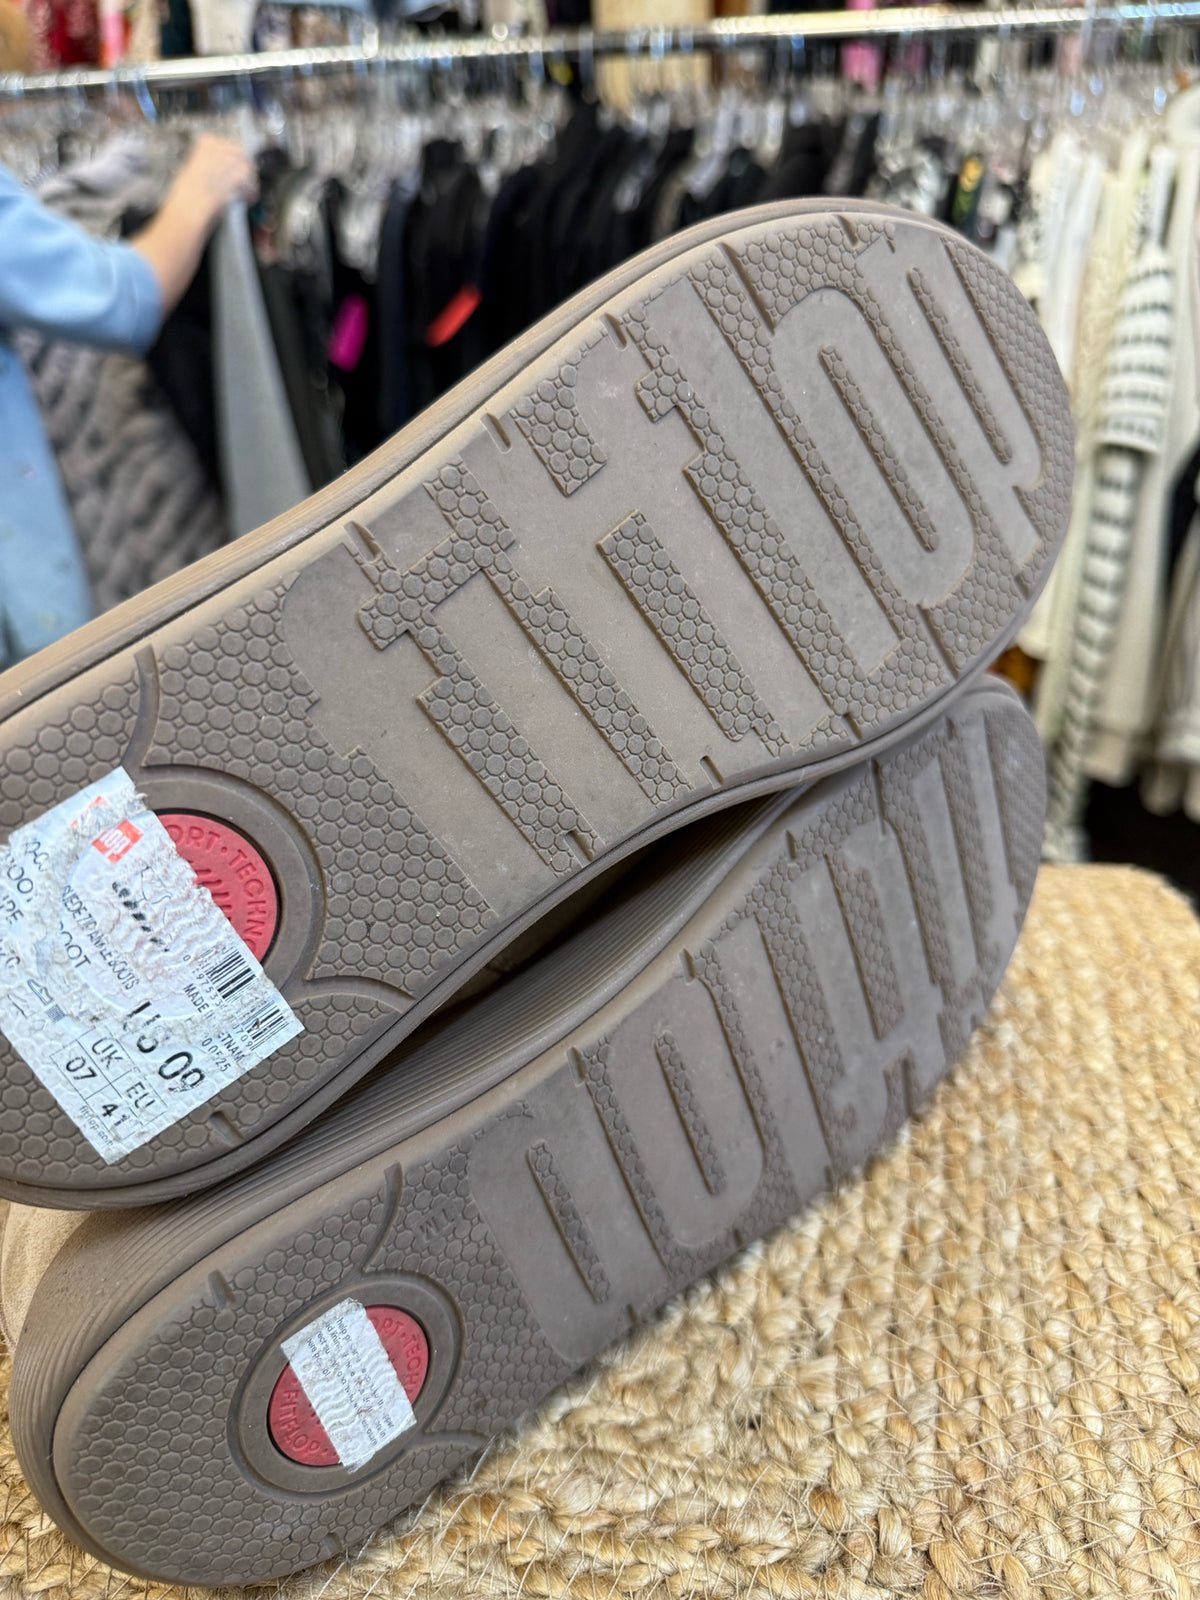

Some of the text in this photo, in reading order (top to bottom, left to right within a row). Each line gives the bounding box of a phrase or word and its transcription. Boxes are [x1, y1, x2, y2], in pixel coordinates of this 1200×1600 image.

[281, 222, 1046, 918] fitflop
[183, 983, 210, 1013] MADE
[64, 1053, 131, 1127] 07 41
[90, 1035, 156, 1109] UK EU
[155, 1047, 207, 1099] 09
